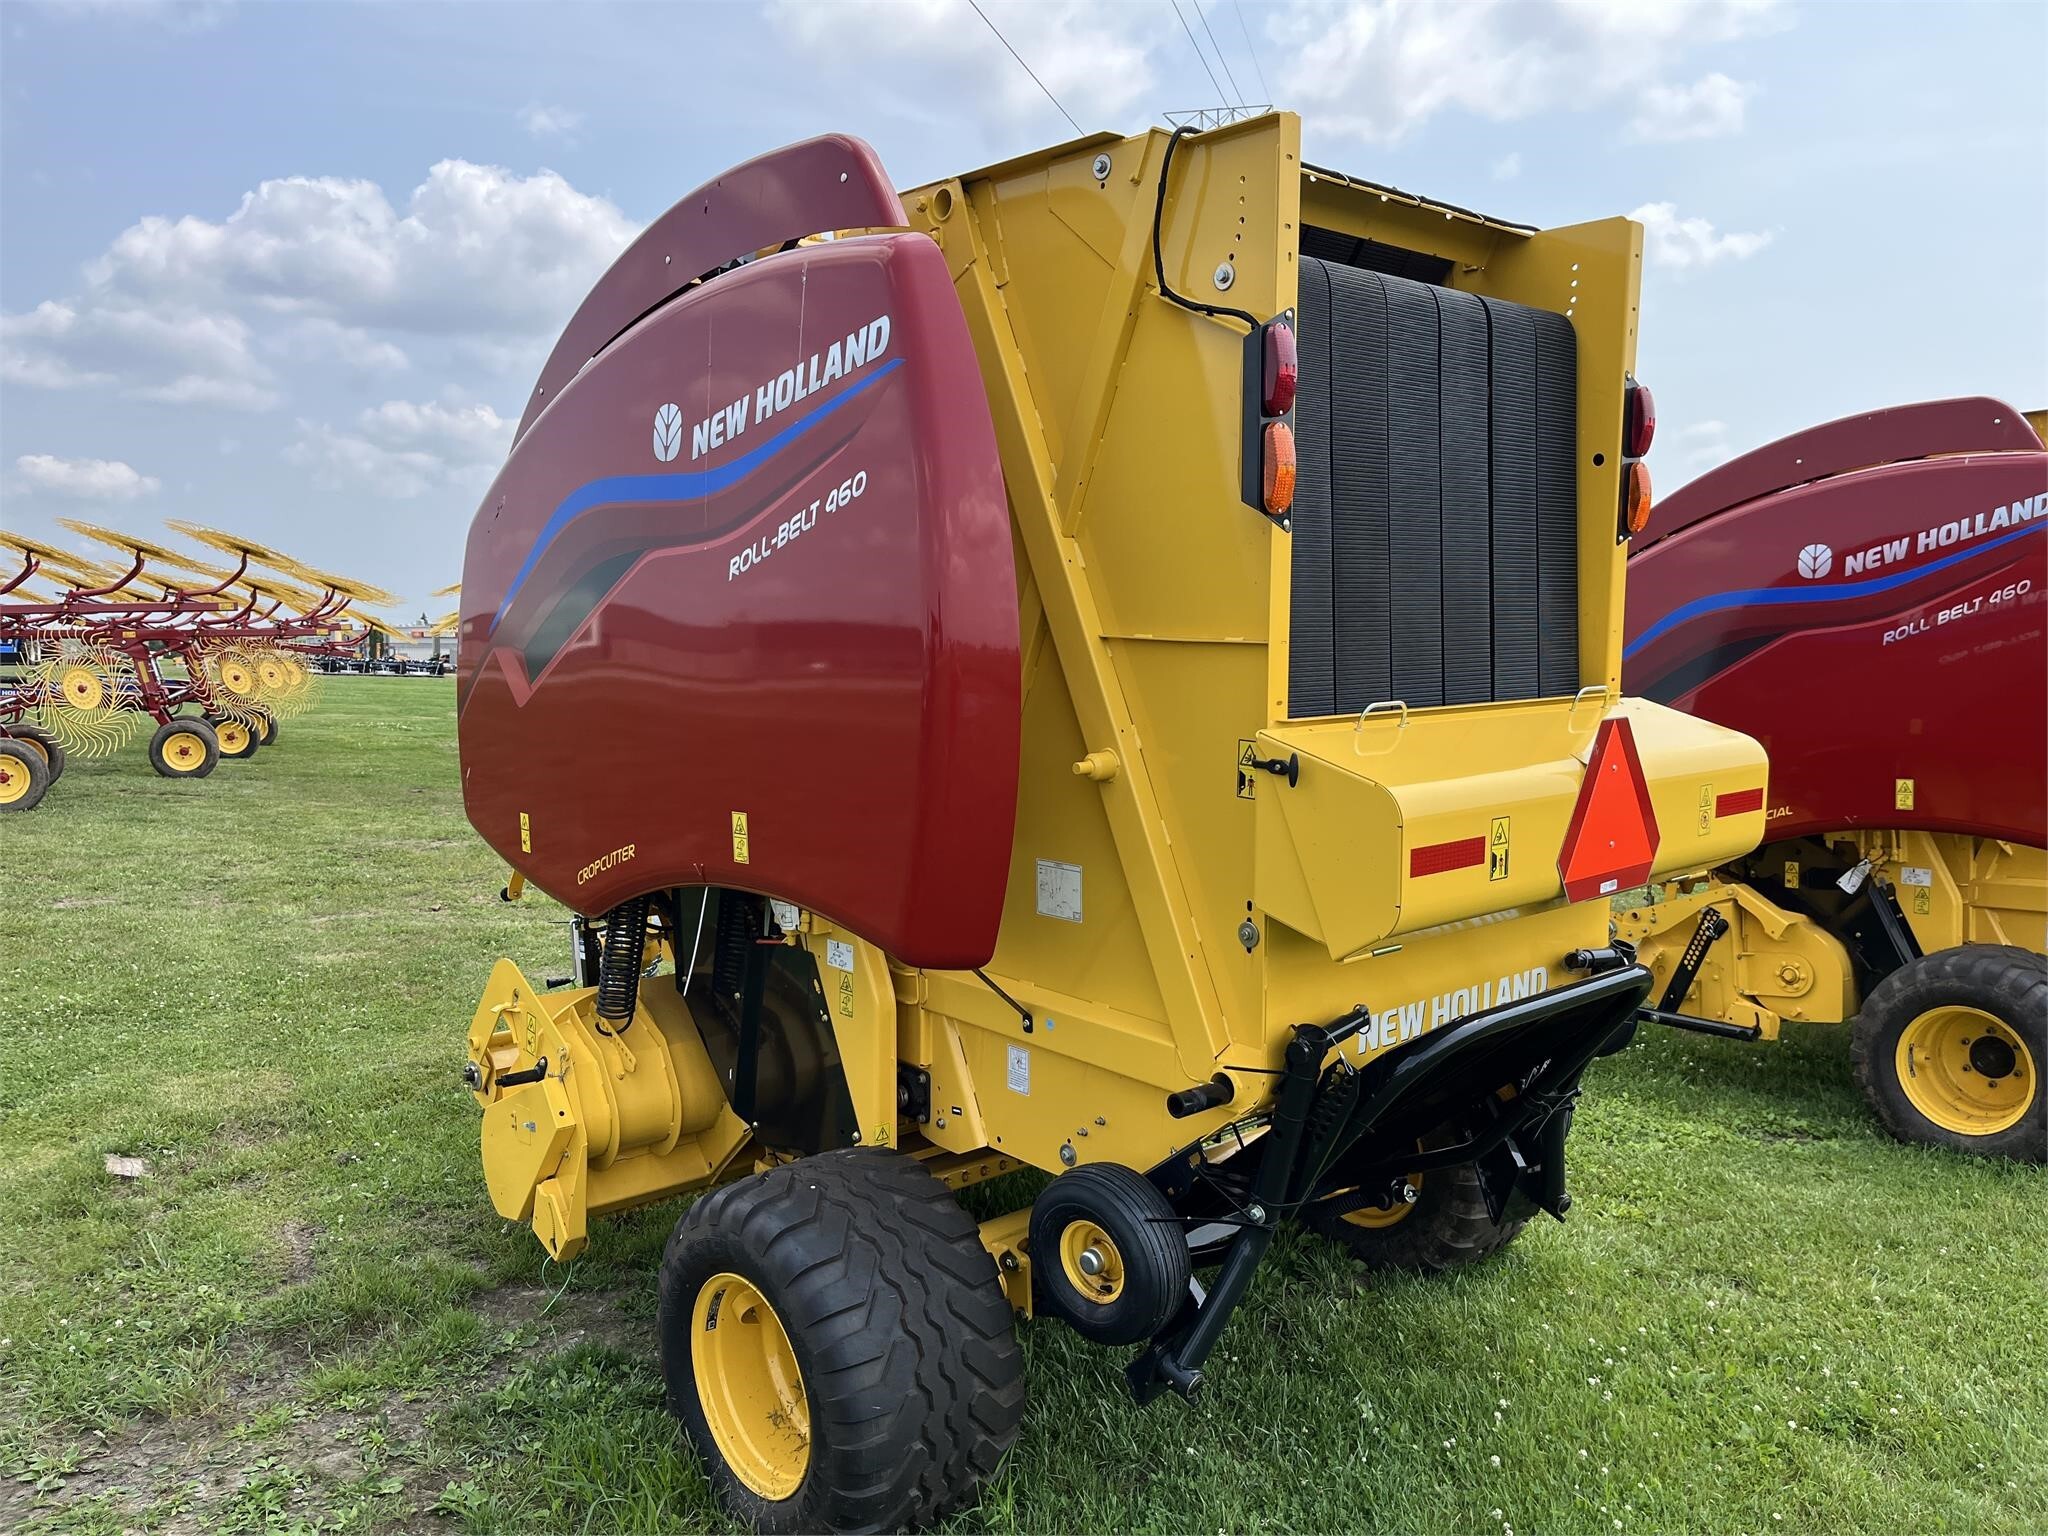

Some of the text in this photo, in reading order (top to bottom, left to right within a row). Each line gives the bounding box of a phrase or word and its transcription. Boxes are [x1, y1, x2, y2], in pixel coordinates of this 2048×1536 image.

[691, 315, 890, 461] NEW HOLLAND
[729, 470, 867, 581] ROLL-BELT 460
[1844, 491, 2048, 577] NEW HOLLAND
[1882, 618, 1930, 646] ROLL
[1937, 596, 1983, 626] BELT
[1989, 579, 2031, 605] 460
[577, 844, 635, 885] CROPCUTTER
[1358, 966, 1549, 1055] NEW HOLLAND
